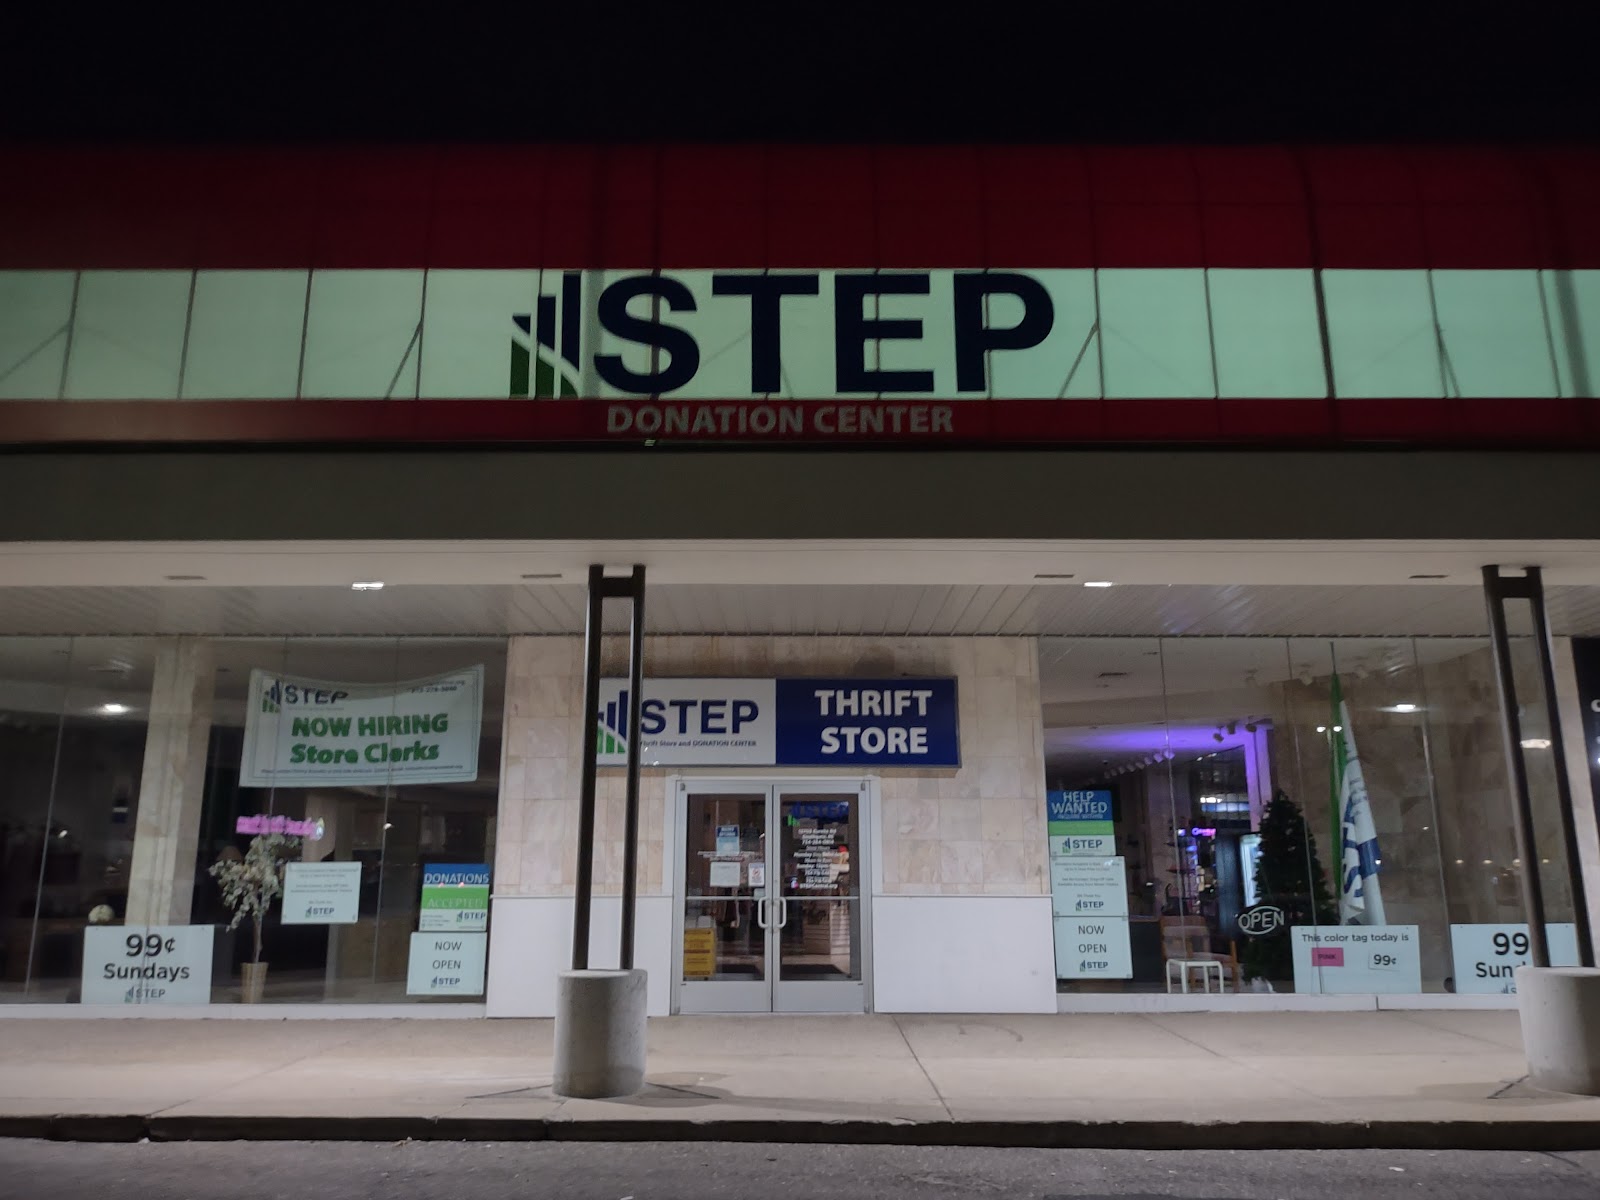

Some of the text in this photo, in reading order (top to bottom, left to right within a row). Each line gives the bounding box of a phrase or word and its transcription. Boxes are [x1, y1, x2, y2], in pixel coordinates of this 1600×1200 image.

[593, 272, 1055, 394] STEP
[607, 405, 954, 433] DONATION CENTER
[284, 684, 349, 705] STEP
[814, 689, 933, 717] THRIFT
[641, 699, 759, 735] STEP
[291, 713, 448, 737] NOW HIRING
[820, 726, 929, 754] STORE
[290, 741, 440, 764] Store Clerks
[1063, 791, 1095, 803] HELP
[1051, 802, 1108, 814] WANTED
[1072, 839, 1103, 849] STEP
[424, 873, 489, 884] DONATIONS
[427, 898, 482, 908] ACCEPTED
[1082, 900, 1104, 909] STEP
[313, 907, 335, 915] STEP
[464, 912, 486, 920] STEP
[1238, 910, 1285, 930] OPEN
[1078, 925, 1105, 935] NOW
[1301, 933, 1409, 943] This color tag today is
[125, 933, 176, 957] 99¢
[434, 941, 462, 951] NOW
[1078, 943, 1107, 954] OPEN
[432, 959, 461, 970] OPEN
[1087, 961, 1109, 969] STEP
[1475, 961, 1527, 978] Sun
[103, 962, 191, 983] Sundays
[438, 977, 461, 985] STEP
[136, 988, 166, 999] STEP
